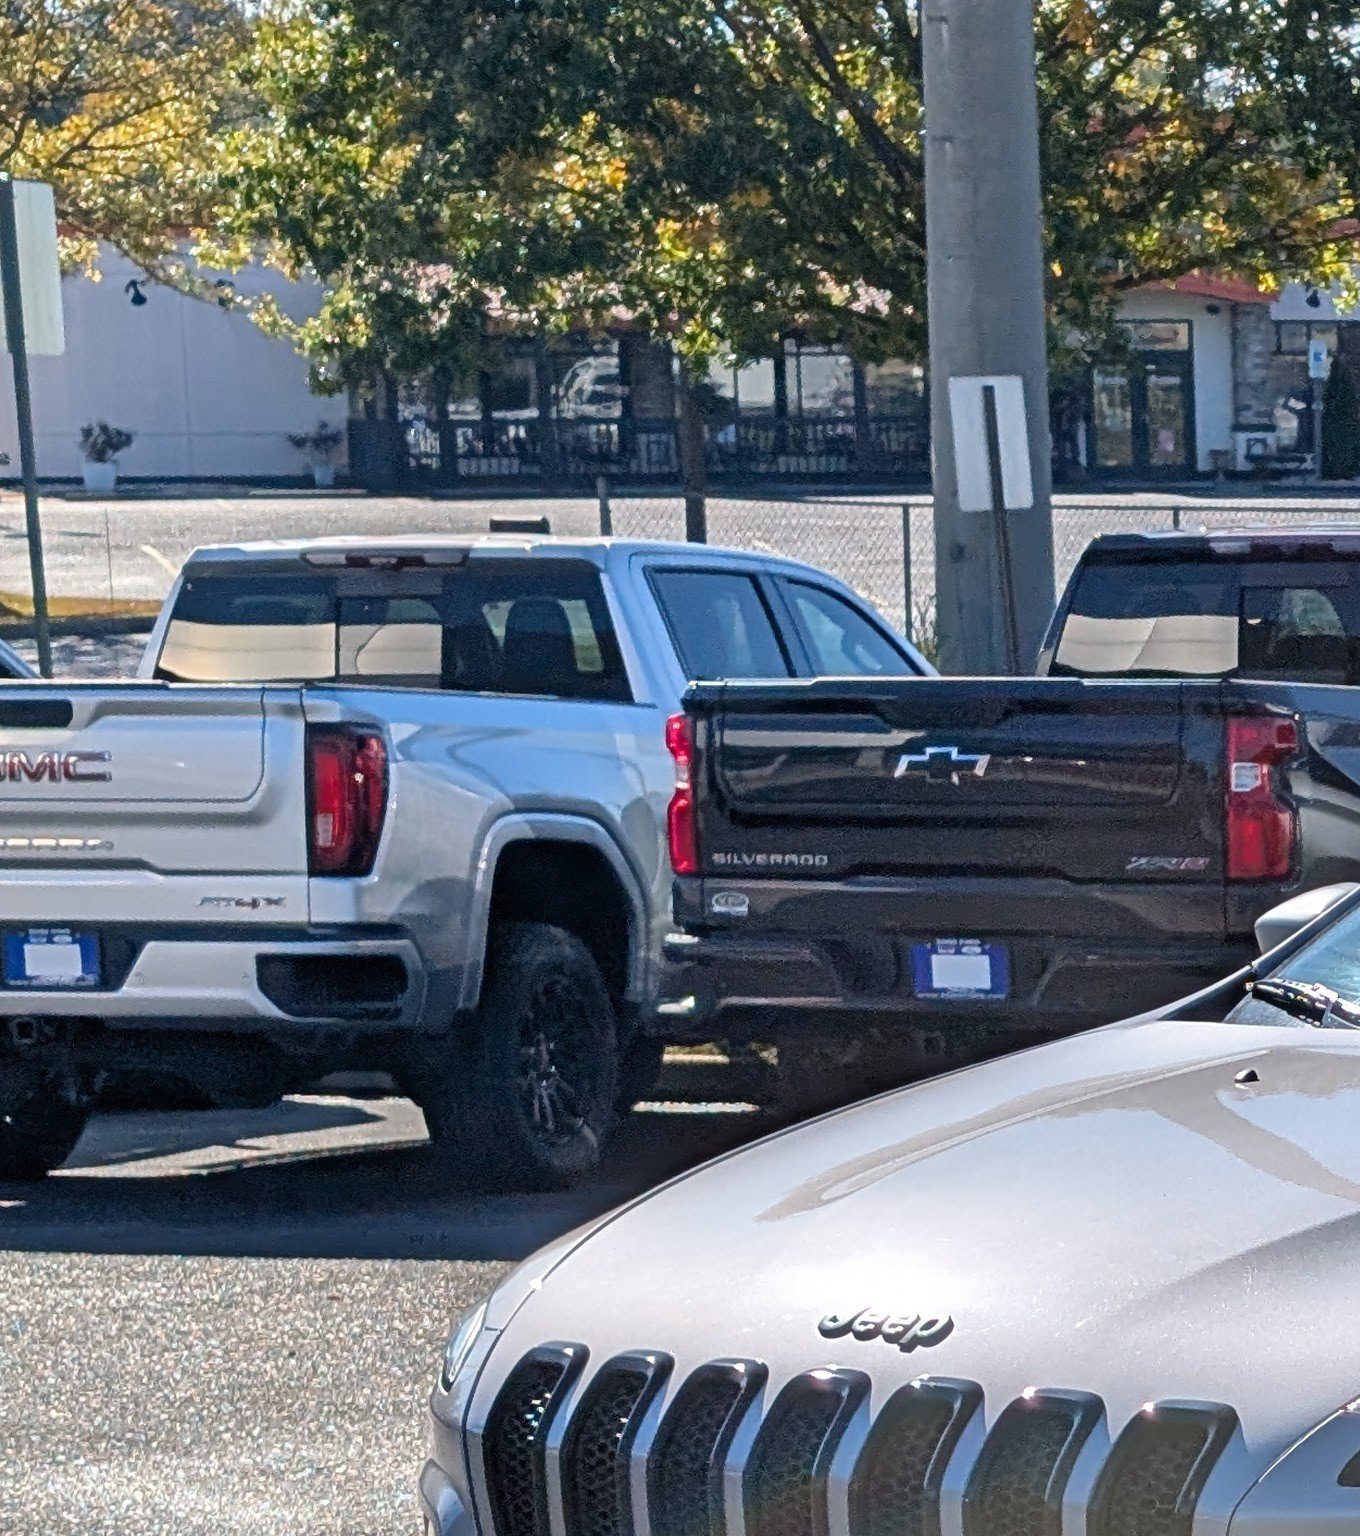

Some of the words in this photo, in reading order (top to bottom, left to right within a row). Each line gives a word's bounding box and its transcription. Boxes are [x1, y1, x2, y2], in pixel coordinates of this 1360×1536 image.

[0, 750, 113, 782] MC
[711, 852, 828, 866] SILVERADO
[817, 1306, 955, 1354] Jeep
